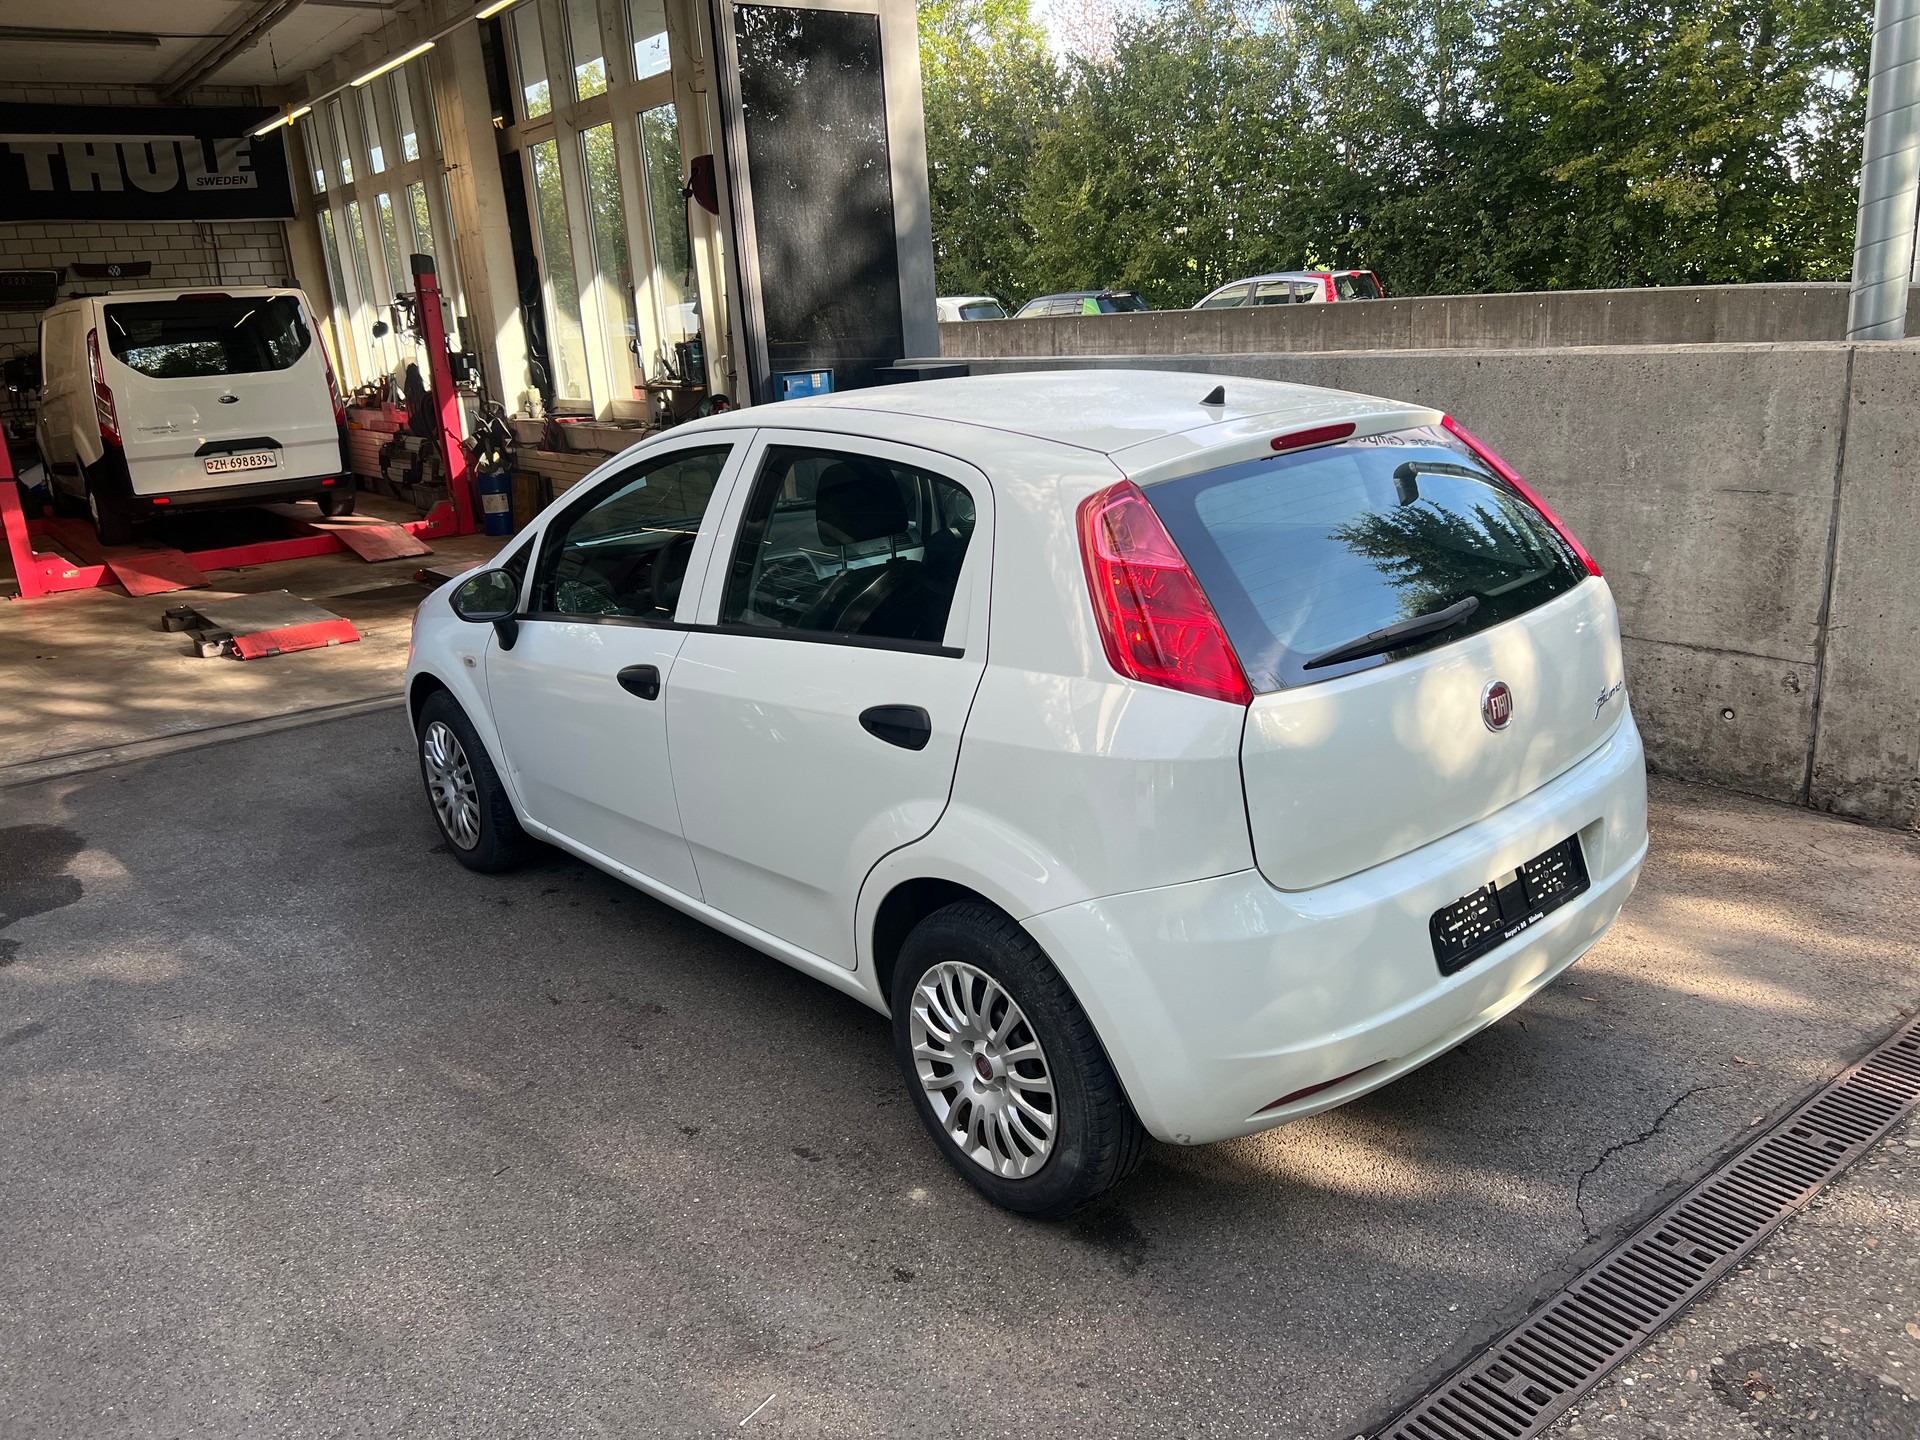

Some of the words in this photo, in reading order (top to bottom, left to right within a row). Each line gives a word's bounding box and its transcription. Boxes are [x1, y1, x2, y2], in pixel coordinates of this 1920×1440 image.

[8, 138, 258, 193] THULE
[195, 175, 248, 187] SWEDEN
[1490, 693, 1508, 720] FIAT
